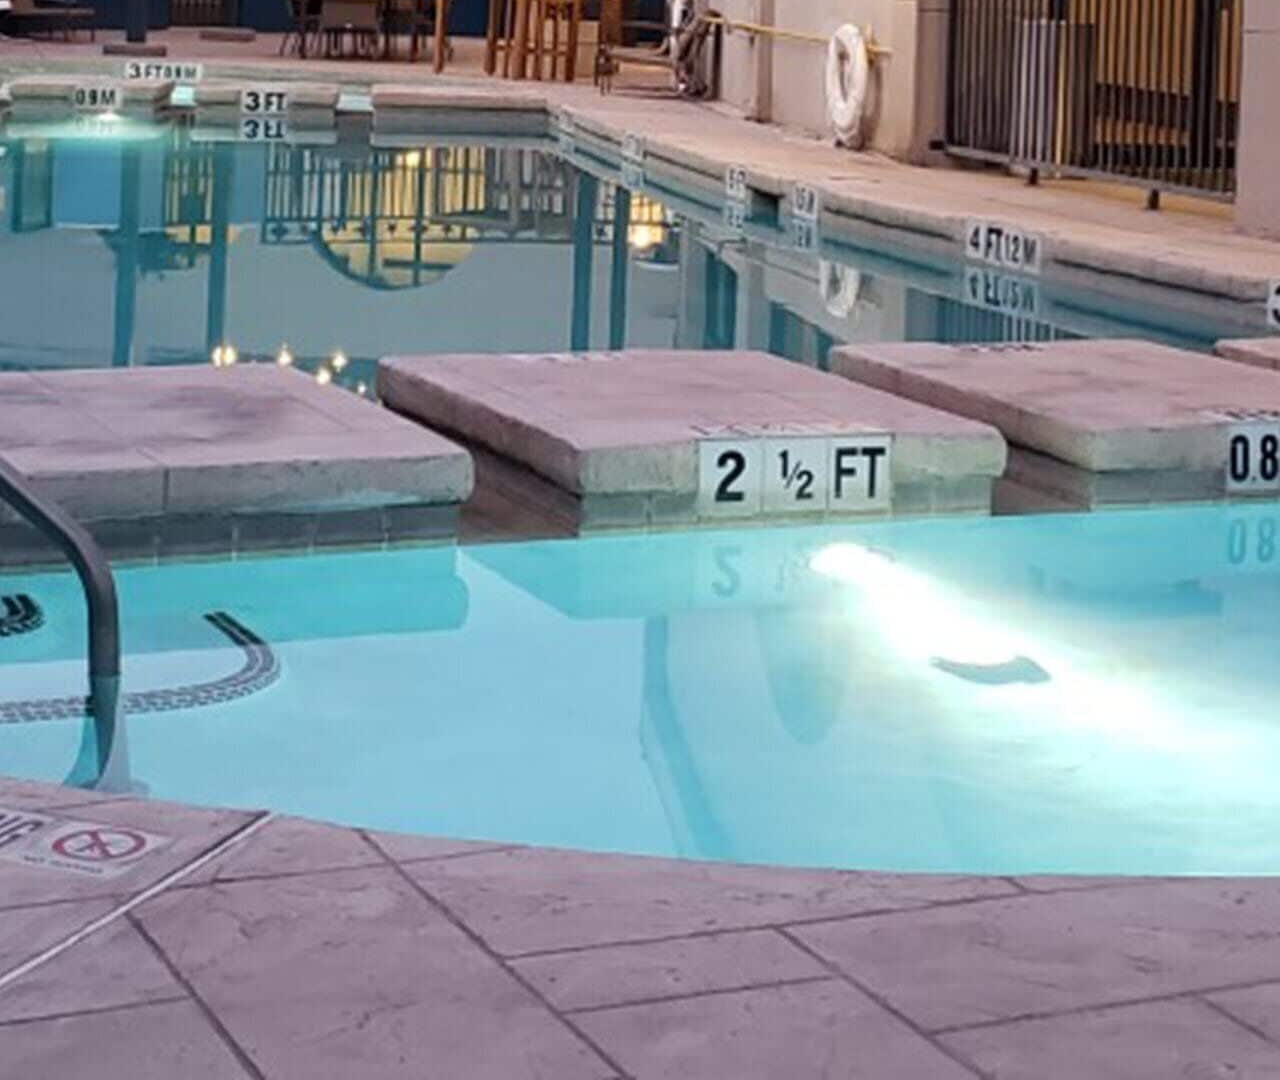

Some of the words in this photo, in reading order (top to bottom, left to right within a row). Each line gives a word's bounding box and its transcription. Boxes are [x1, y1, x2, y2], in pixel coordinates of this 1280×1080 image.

[244, 92, 260, 111] 3
[264, 92, 287, 112] FT
[713, 449, 747, 503] 2
[834, 447, 887, 499] FT
